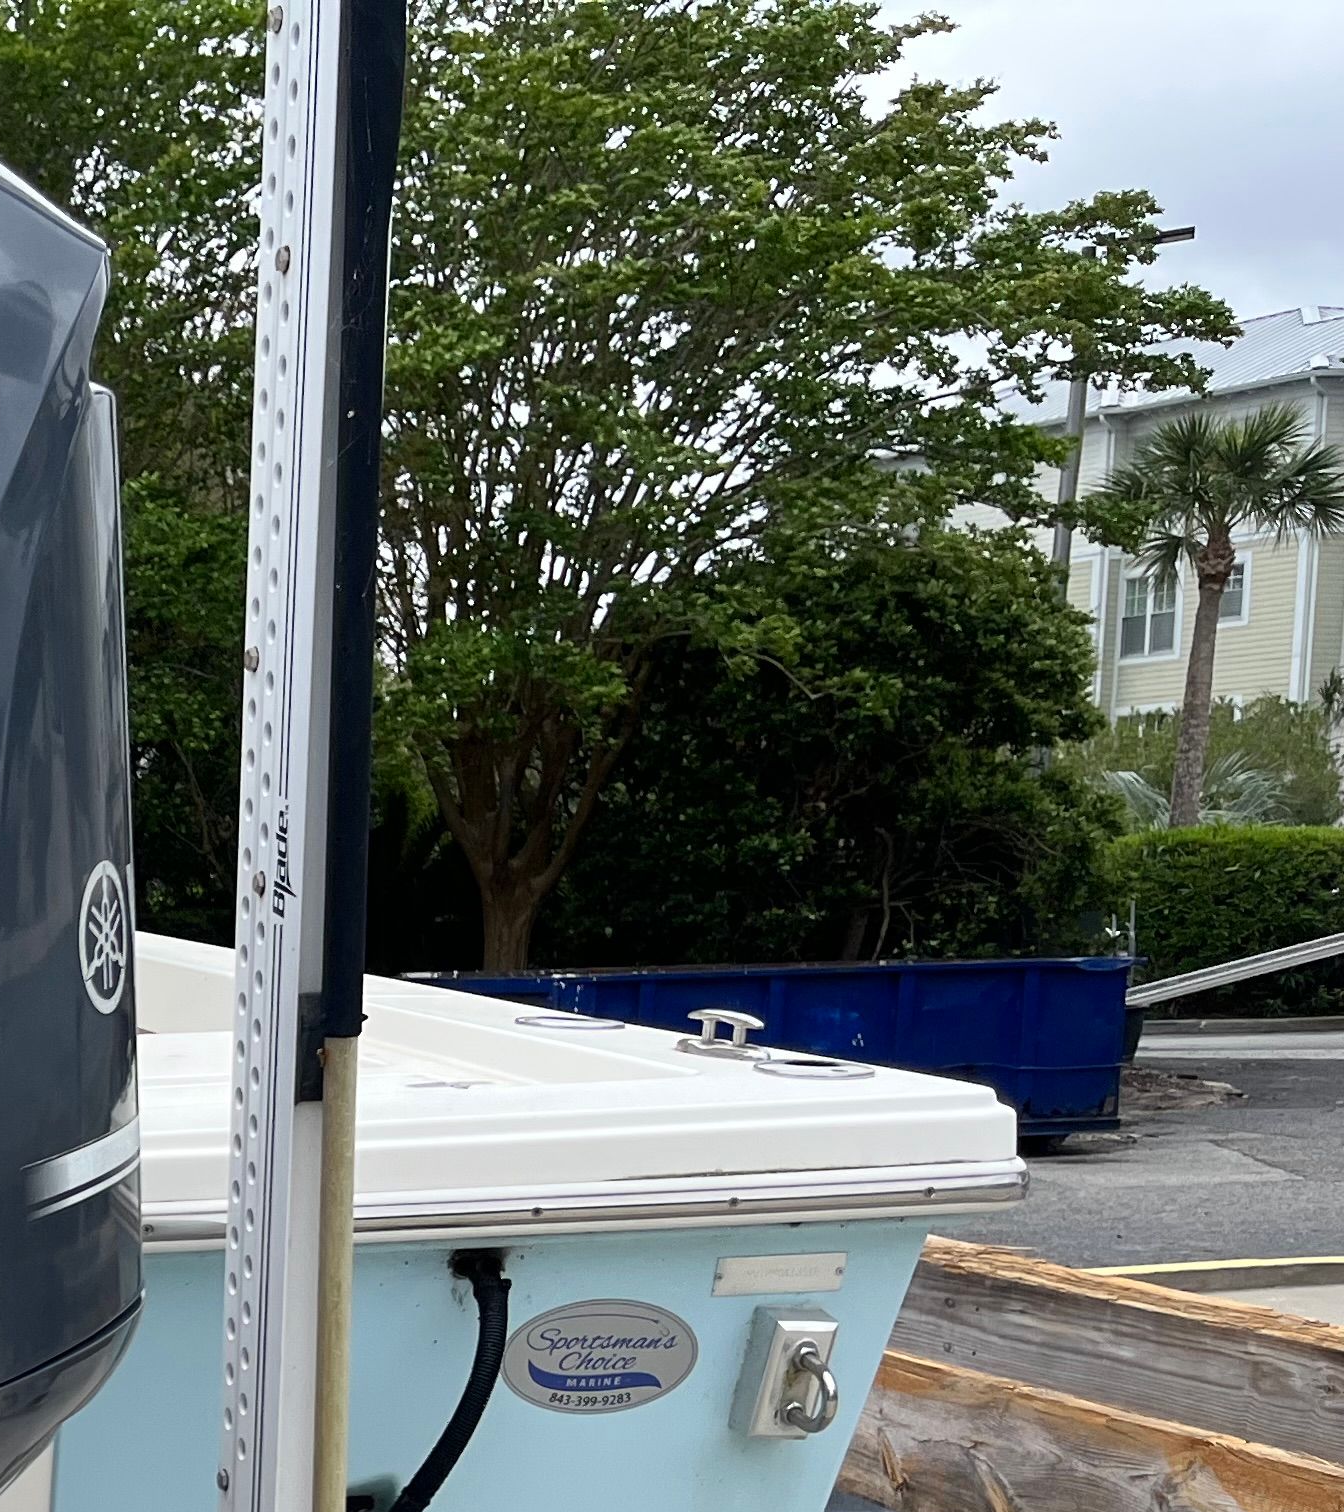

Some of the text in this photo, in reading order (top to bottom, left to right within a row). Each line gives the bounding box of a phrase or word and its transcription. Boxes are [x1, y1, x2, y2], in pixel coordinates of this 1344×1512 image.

[272, 808, 297, 919] Blade
[534, 1327, 678, 1356] Sportsman's
[558, 1351, 637, 1371] Choice
[565, 1375, 622, 1388] MARINE
[548, 1391, 632, 1407] 843-399-9283
